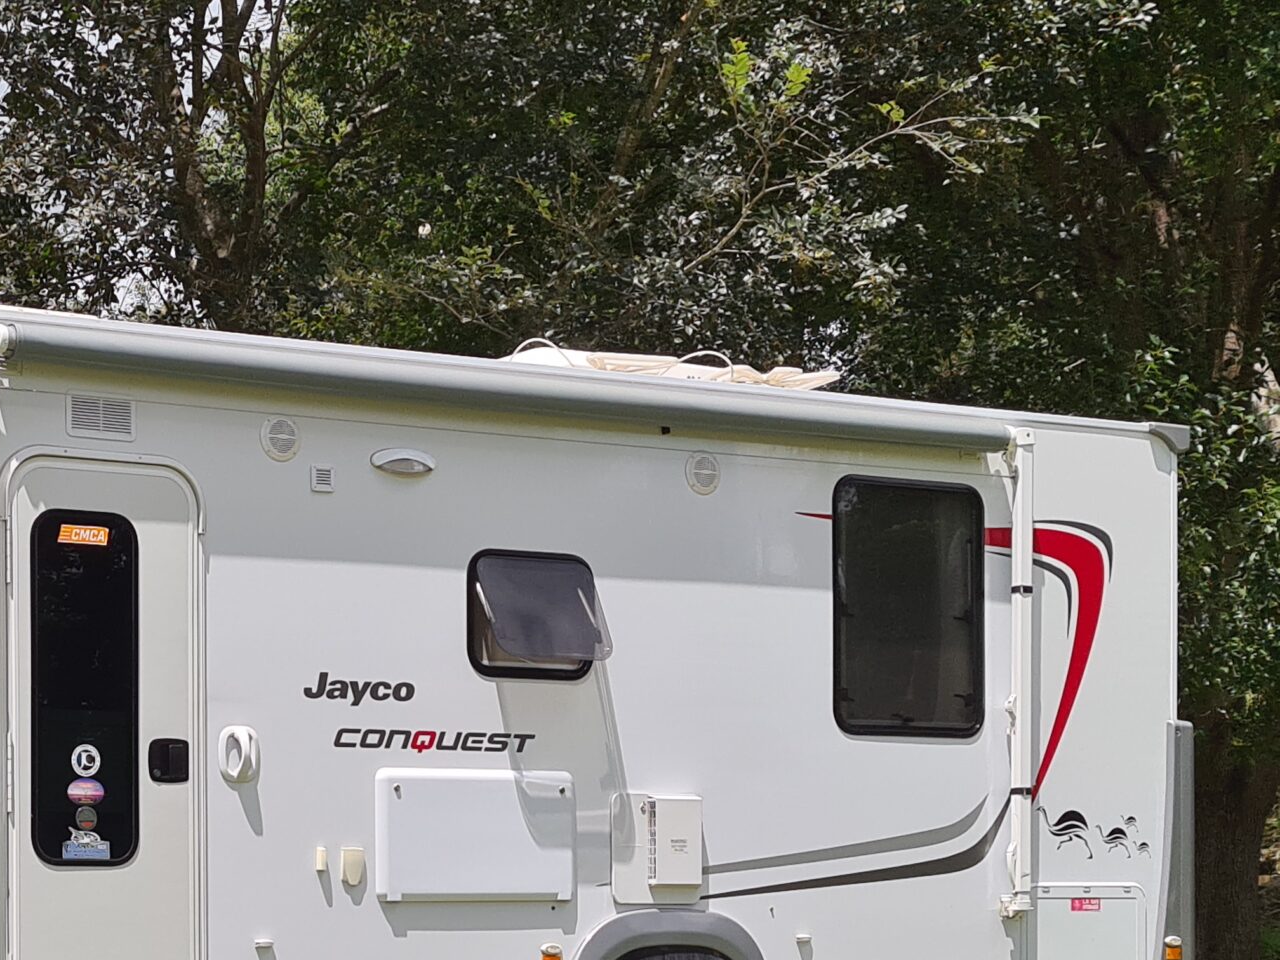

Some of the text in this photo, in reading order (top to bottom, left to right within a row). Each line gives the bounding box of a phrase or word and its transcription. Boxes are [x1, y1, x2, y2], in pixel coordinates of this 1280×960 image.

[71, 528, 105, 542] CMCA
[303, 671, 415, 706] Jayco
[333, 728, 536, 753] CONQUEST
